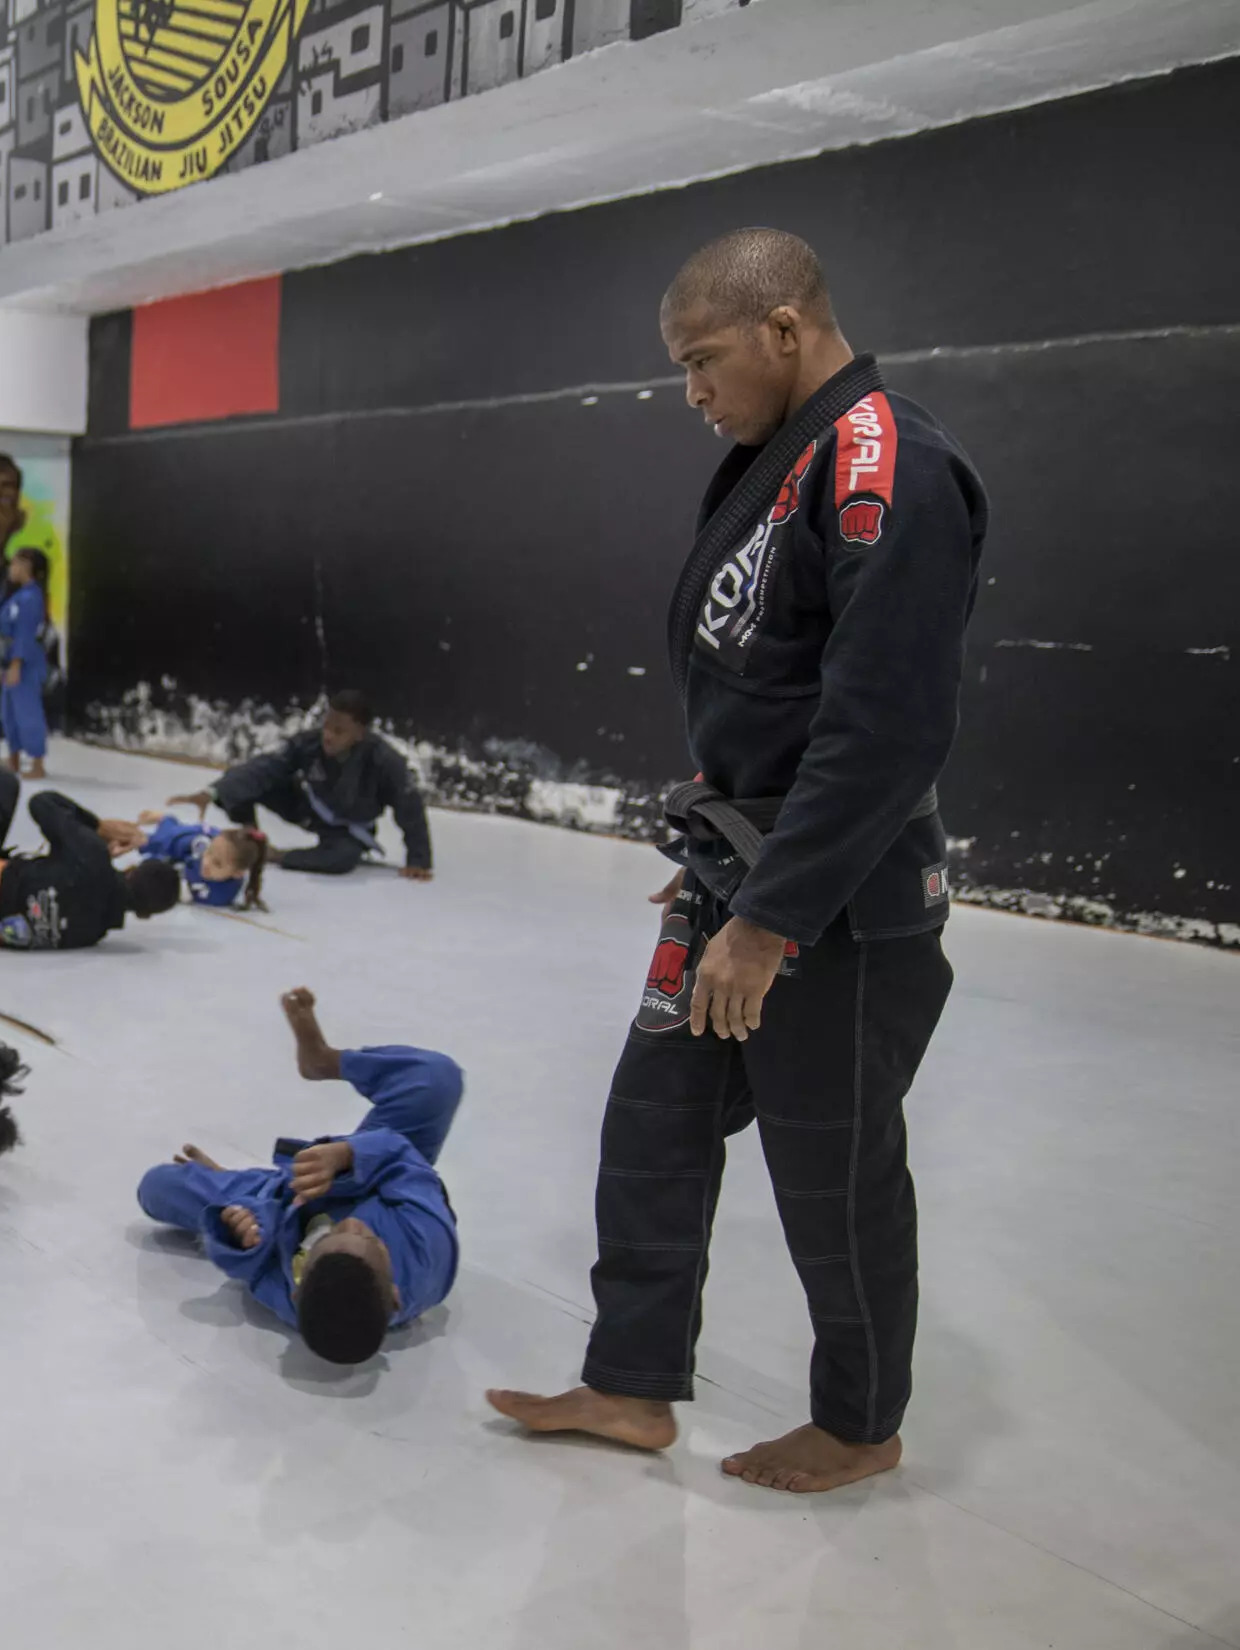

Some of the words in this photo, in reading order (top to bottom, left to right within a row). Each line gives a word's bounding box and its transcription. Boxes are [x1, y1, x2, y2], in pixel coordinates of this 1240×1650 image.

[96, 117, 164, 182] BRAZILIAN
[178, 147, 208, 179] JIU
[217, 76, 267, 154] JITSU
[108, 65, 166, 134] JACKSON
[200, 19, 263, 117] SOUSA
[846, 396, 882, 491] KORAL
